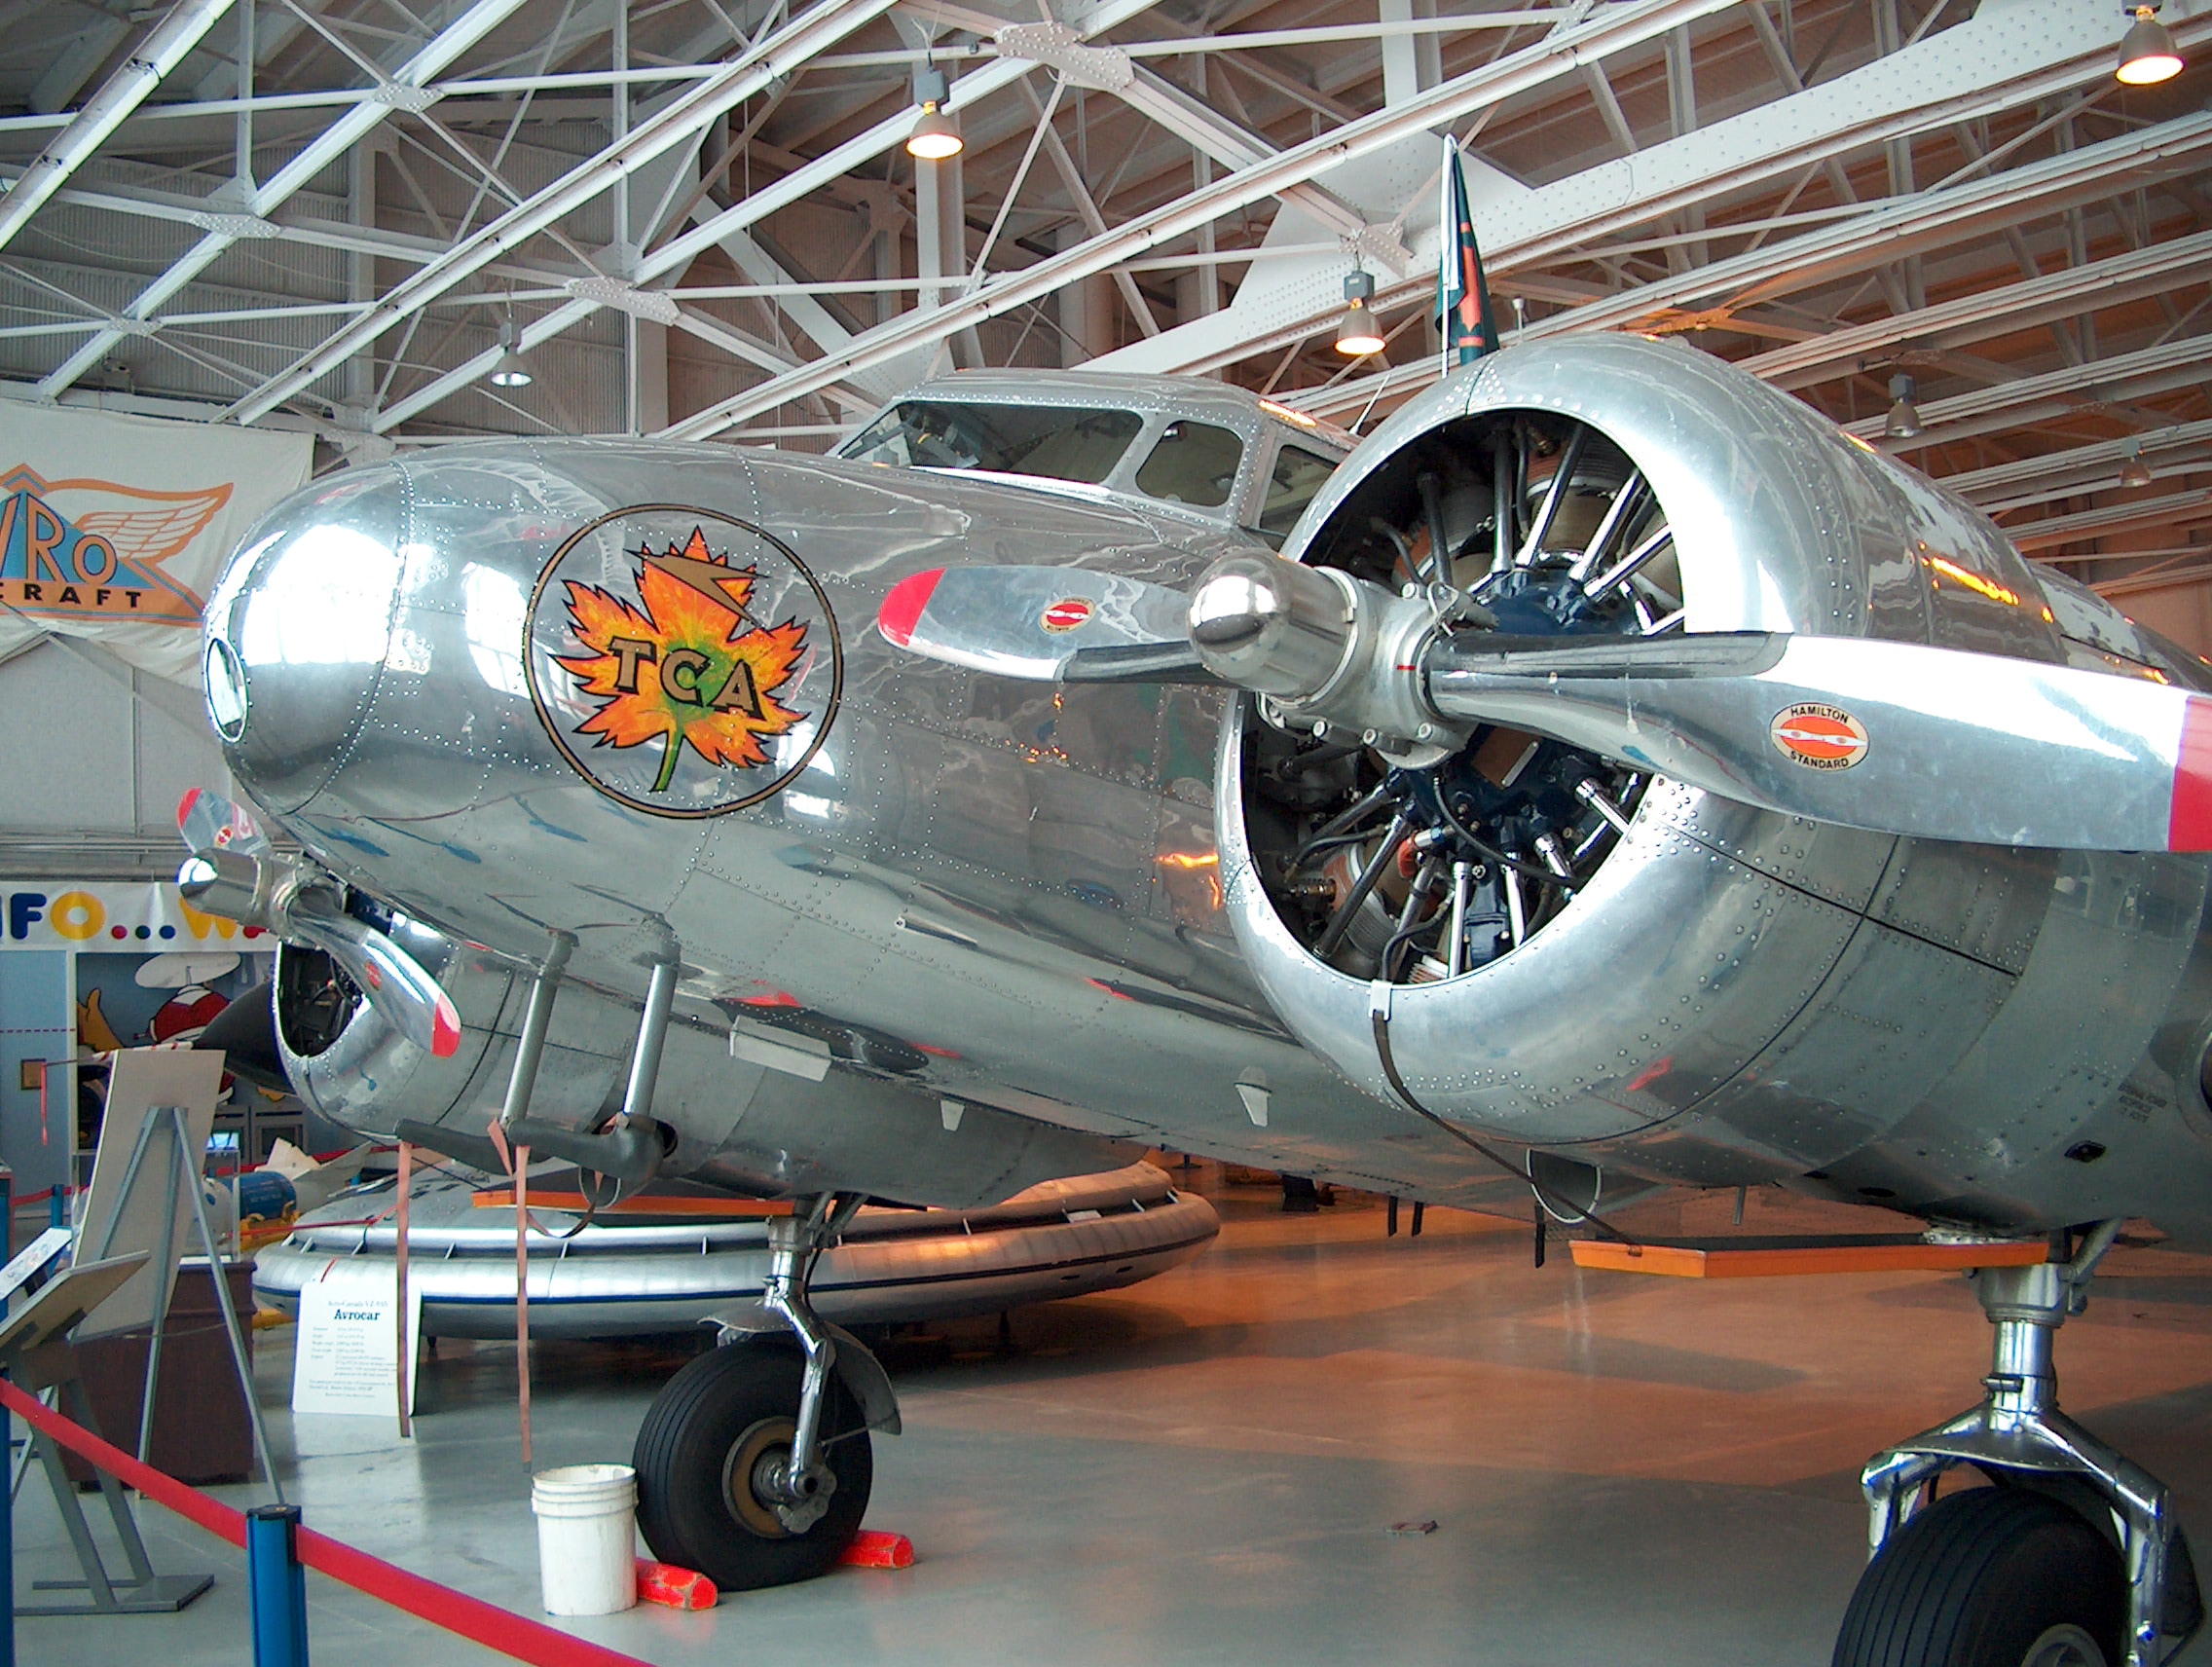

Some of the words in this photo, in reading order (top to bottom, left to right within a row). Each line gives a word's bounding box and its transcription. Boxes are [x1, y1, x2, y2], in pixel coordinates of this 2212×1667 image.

[0, 582, 141, 608] RAFT
[608, 636, 766, 721] TCA
[1790, 706, 1849, 723] HAMILTON
[1790, 751, 1849, 769] STANDARD
[334, 1309, 381, 1320] Avrocar
